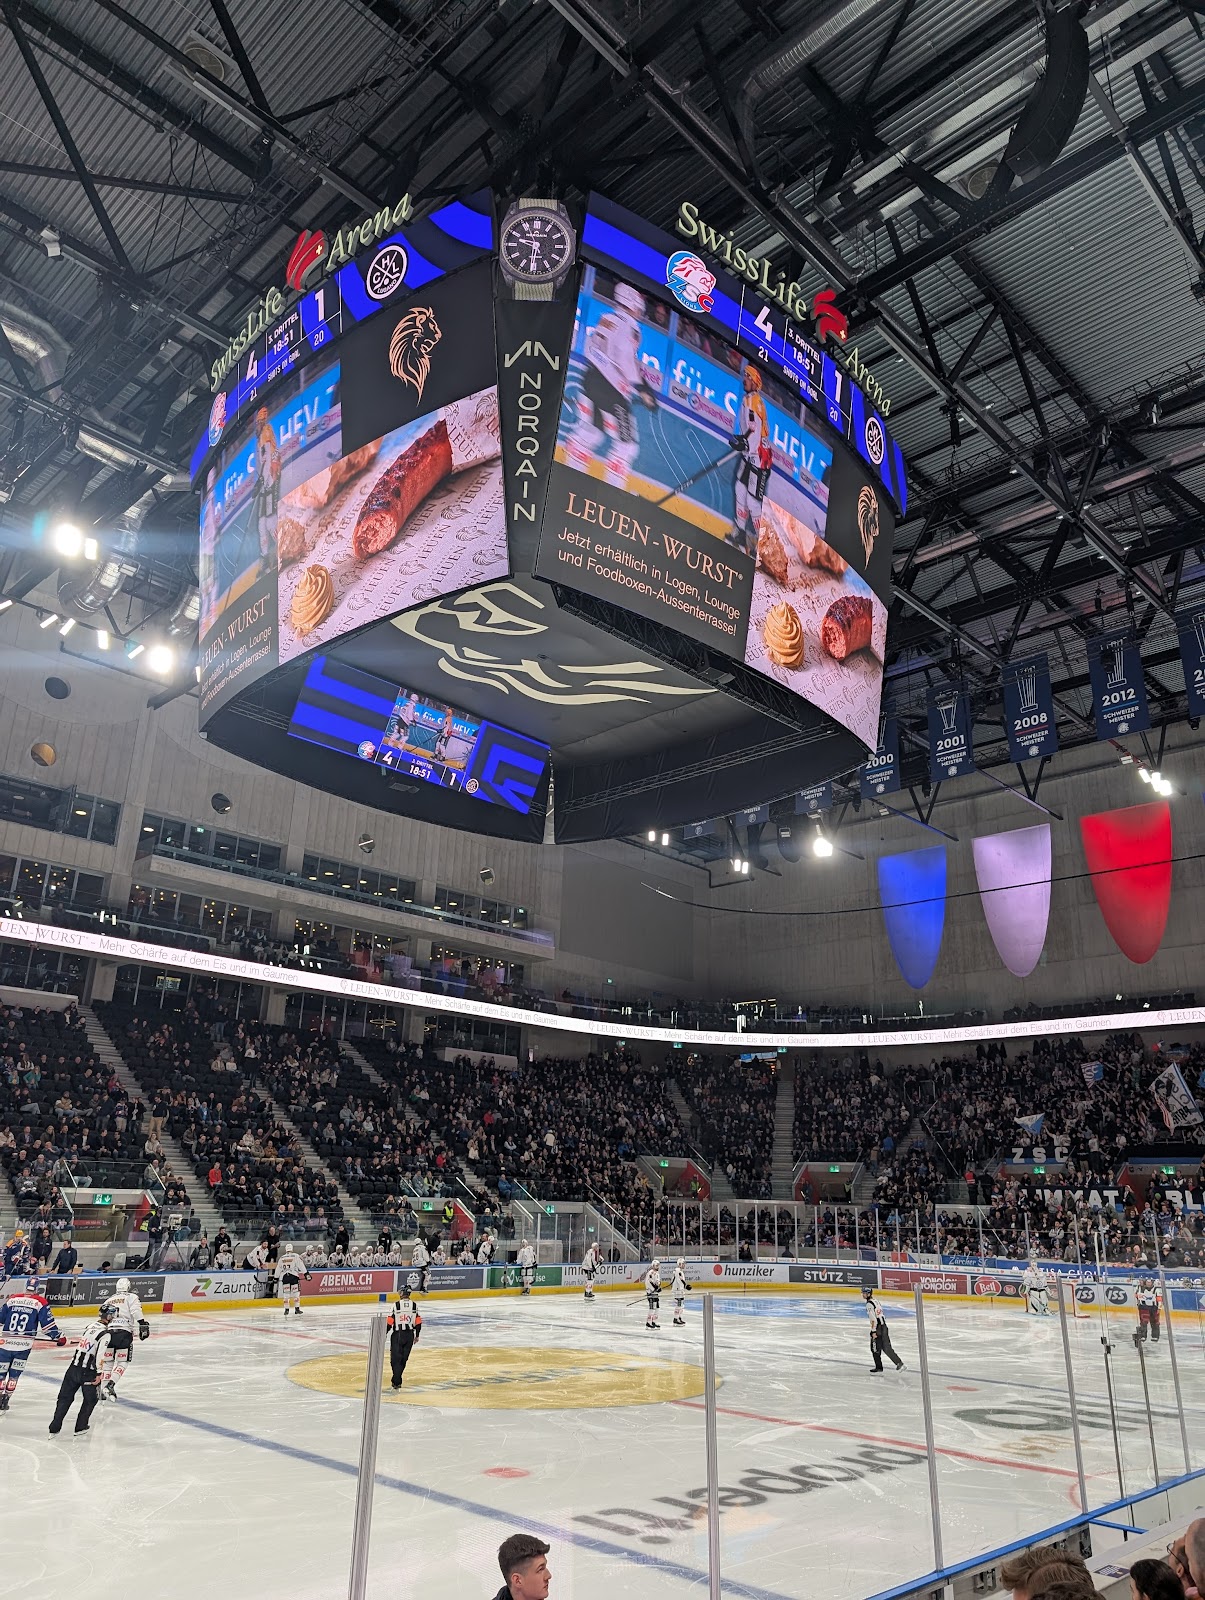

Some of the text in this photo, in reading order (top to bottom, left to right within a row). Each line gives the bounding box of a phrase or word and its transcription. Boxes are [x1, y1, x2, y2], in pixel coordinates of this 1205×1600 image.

[211, 193, 412, 392] SwissLife Arena
[665, 273, 714, 312] ZSC
[315, 290, 325, 322] 1
[676, 201, 891, 416] SwissLife Arena
[680, 297, 697, 310] LIONS
[273, 312, 298, 338] DRITTEL
[754, 306, 773, 342] 4
[273, 329, 294, 355] 18:51
[313, 330, 324, 347] 20
[788, 328, 821, 364] 3. DRITTEL
[758, 346, 769, 362] 21
[793, 346, 815, 375] 18:51
[246, 350, 258, 382] 4
[783, 365, 799, 384] SHOTS
[249, 387, 258, 402] 21
[834, 369, 843, 404] 1
[829, 406, 838, 422] 20
[512, 372, 542, 522] NORQAIN
[558, 526, 591, 551] Jetzt
[594, 541, 648, 575] erhältlich
[651, 564, 662, 581] in
[665, 570, 701, 601] Logen,
[704, 590, 741, 620] Lounge
[558, 549, 738, 637] und Foodboxen-Aussenterrasse!
[230, 644, 248, 663] Logen,
[249, 626, 272, 649] Lounge
[1101, 688, 1136, 706] 2012
[1014, 712, 1048, 731] 2008
[1103, 705, 1139, 721] SCHWEIZER
[1108, 712, 1135, 725] MEISTER
[936, 734, 965, 751] 2001
[1016, 729, 1049, 744] SCHWEIZER
[1020, 736, 1045, 748] MEISTER
[382, 751, 393, 765] 4
[866, 753, 894, 769] 2000
[936, 751, 967, 763] SCHWEIZER
[941, 757, 963, 768] MEISTER
[409, 764, 431, 779] 18:51
[449, 772, 457, 786] 1
[866, 769, 894, 782] SCHWEIZER
[869, 775, 890, 785] MEISTER
[99, 938, 126, 953] Mehr
[129, 943, 169, 959] Schärfe
[171, 952, 187, 963] auf
[189, 955, 210, 967] dem
[213, 958, 227, 970] Eis
[229, 962, 247, 974] und
[249, 964, 260, 976] im
[262, 967, 299, 983] Gaumen
[425, 995, 442, 1006] Mehr
[472, 1004, 484, 1013] auf
[484, 1005, 499, 1016] dem
[500, 1008, 510, 1017] Eis
[511, 1010, 523, 1020] und
[524, 1012, 532, 1020] im
[533, 1013, 558, 1026] Gaumen
[943, 1030, 962, 1039] Mehr
[996, 1026, 1008, 1035] auf
[1010, 1025, 1028, 1034] dem
[1030, 1023, 1042, 1033] Eis
[1045, 1022, 1060, 1031] und
[1062, 1021, 1073, 1030] im
[1075, 1018, 1112, 1029] Gaumen
[664, 1031, 682, 1039] Mehr
[714, 1033, 726, 1042] auf
[728, 1034, 744, 1043] dem
[746, 1035, 758, 1043] Eis
[760, 1036, 774, 1044] und
[787, 1036, 820, 1044] Gaumen
[1011, 1146, 1069, 1164] ZSC
[564, 1264, 628, 1276] immcorner
[724, 1264, 775, 1277] hunziker
[320, 1273, 373, 1287] ABENA.CH
[979, 1281, 996, 1293] Bell
[8, 1312, 30, 1333] 83
[399, 1314, 413, 1325] sky
[78, 1337, 95, 1352] sky
